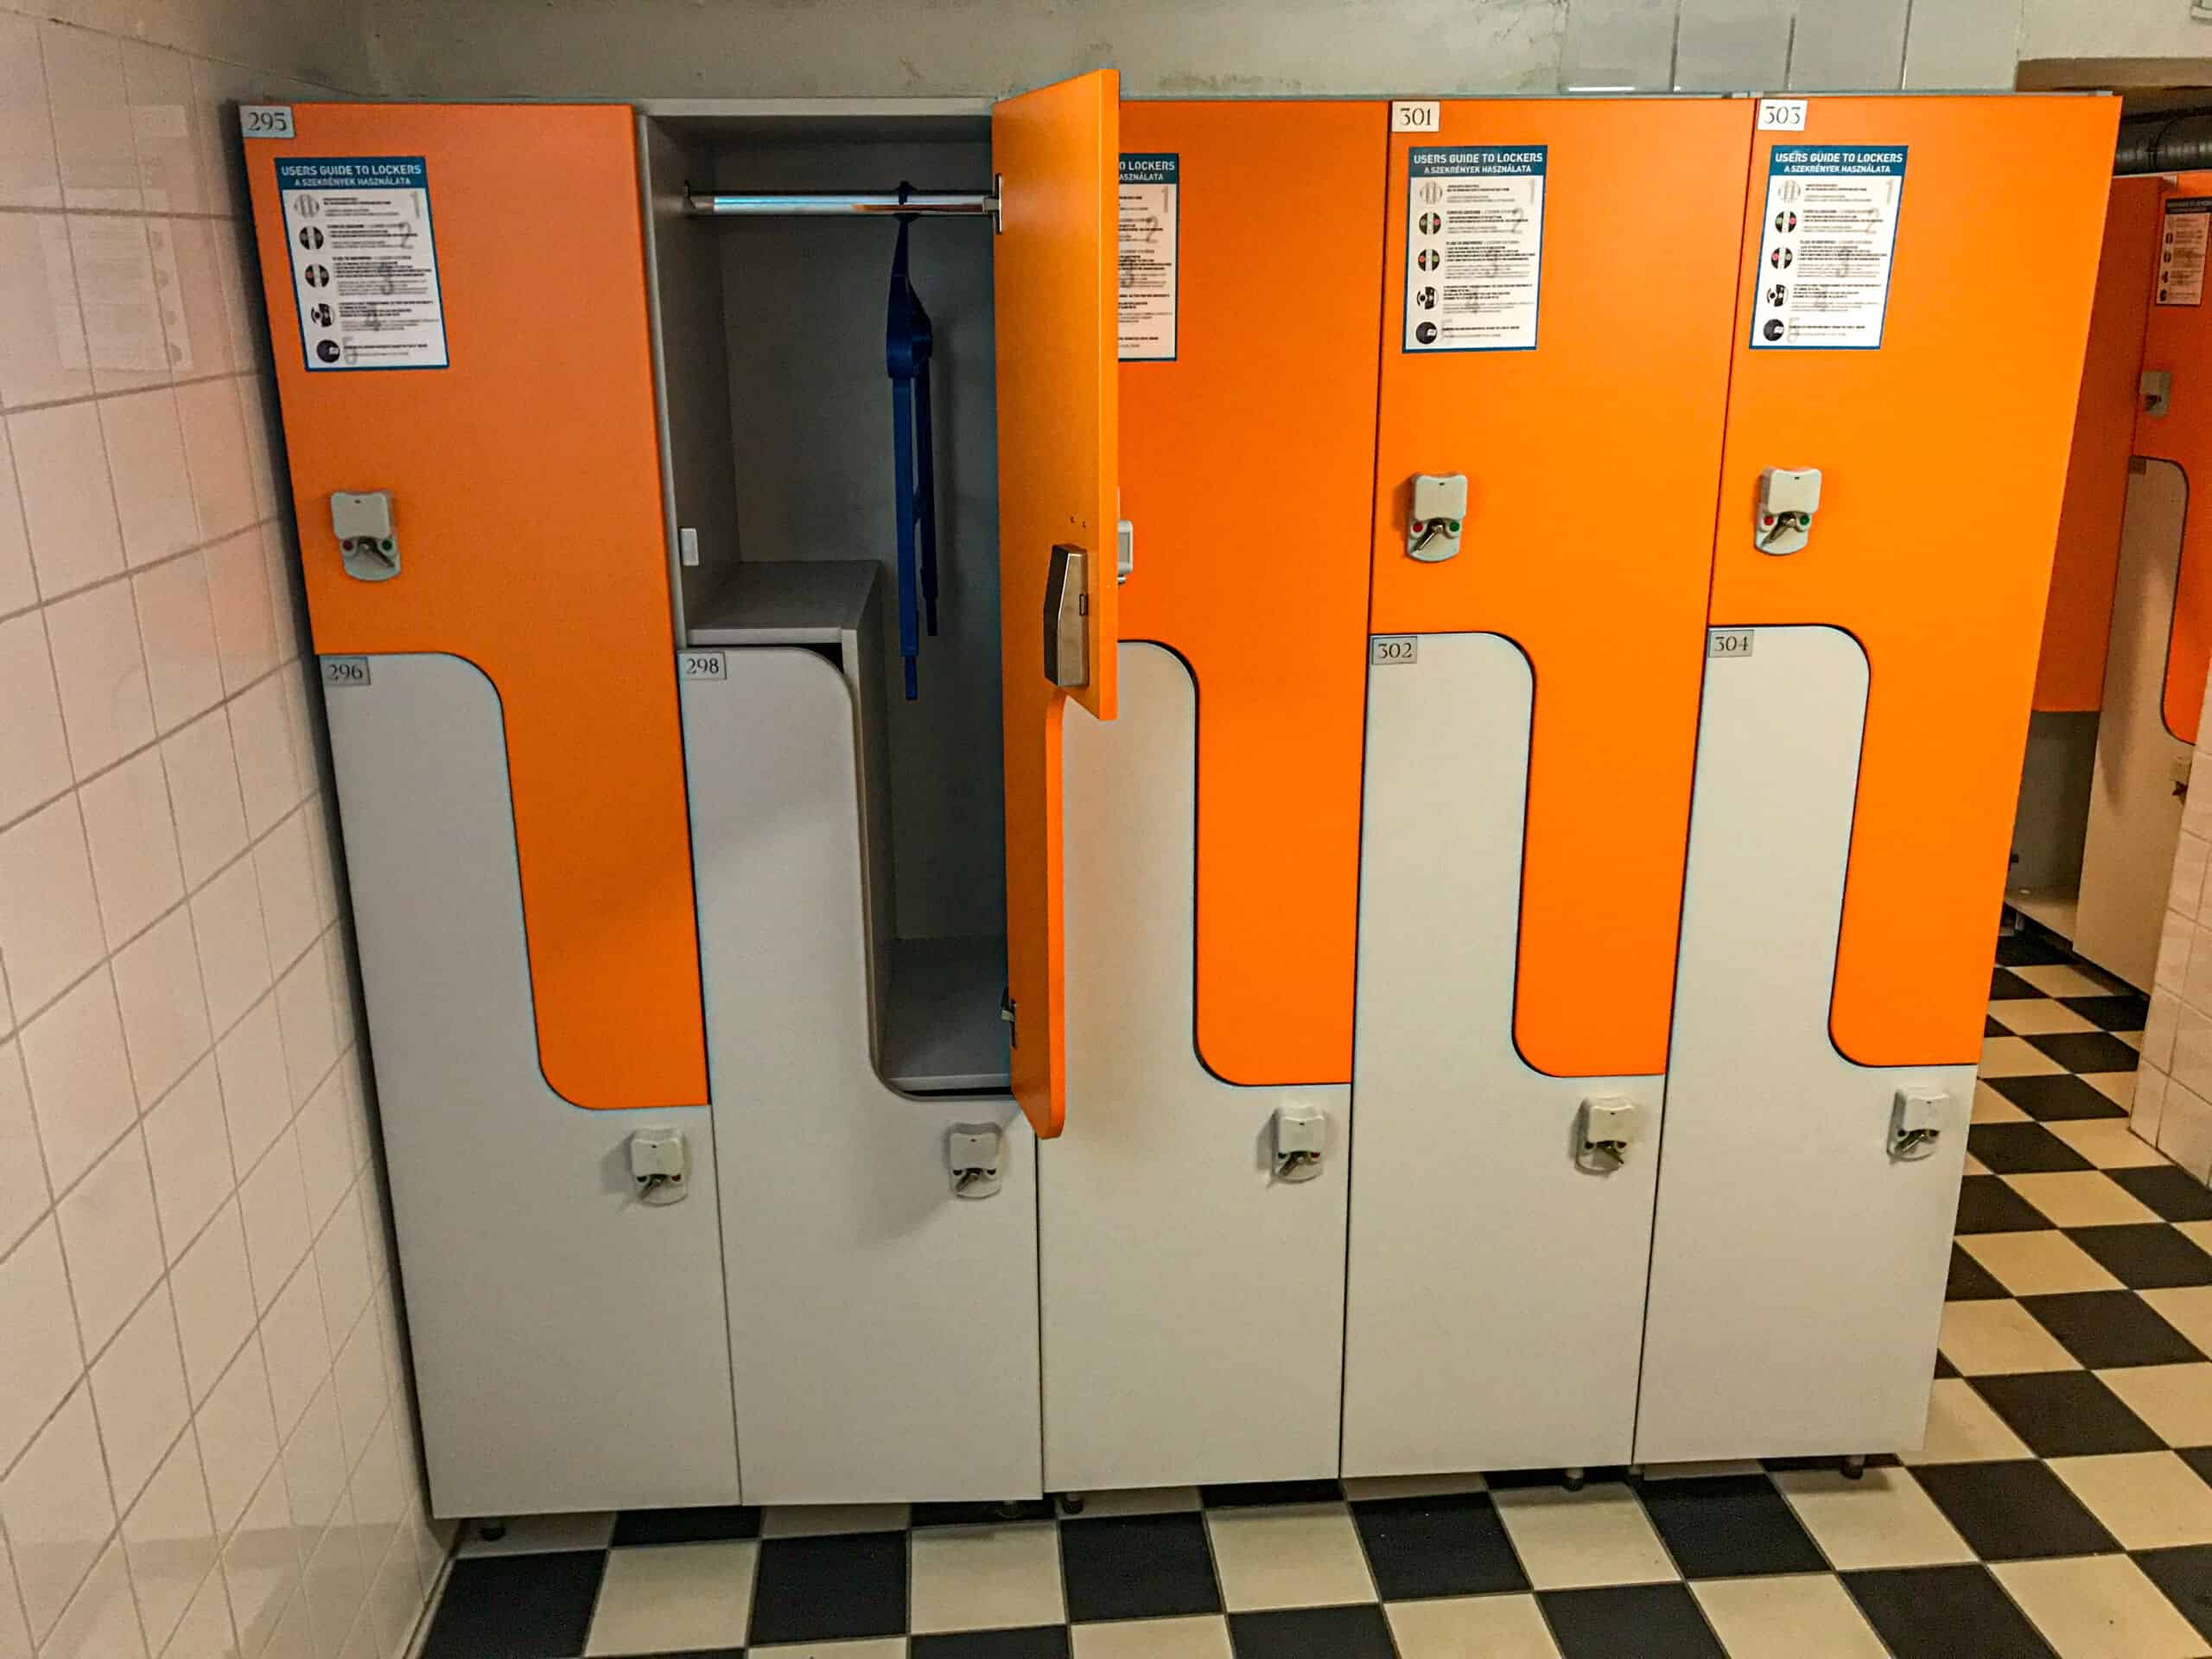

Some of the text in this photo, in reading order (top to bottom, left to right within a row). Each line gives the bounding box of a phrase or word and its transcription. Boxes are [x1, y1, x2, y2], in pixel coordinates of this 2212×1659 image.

[248, 111, 288, 132] 295
[1399, 107, 1433, 126] 301
[1763, 105, 1802, 124] 303
[1128, 160, 1176, 171] LOCKERS
[1414, 152, 1543, 164] USERS GUIDE TO LOCKERS
[1775, 152, 1904, 163] USERS GUIDE TO LOCKERS
[281, 164, 423, 176] USERS GUIDE TO LOCKERS
[1481, 162, 1532, 173] HASZNÁLATA
[1119, 172, 1164, 181] ASZNÁLATA
[1161, 187, 1169, 213] 1
[400, 222, 414, 249] 2
[1146, 215, 1159, 243] 2
[1376, 642, 1413, 658] 302
[1714, 635, 1750, 652] 304
[329, 664, 364, 680] 296
[686, 658, 720, 675] 298
